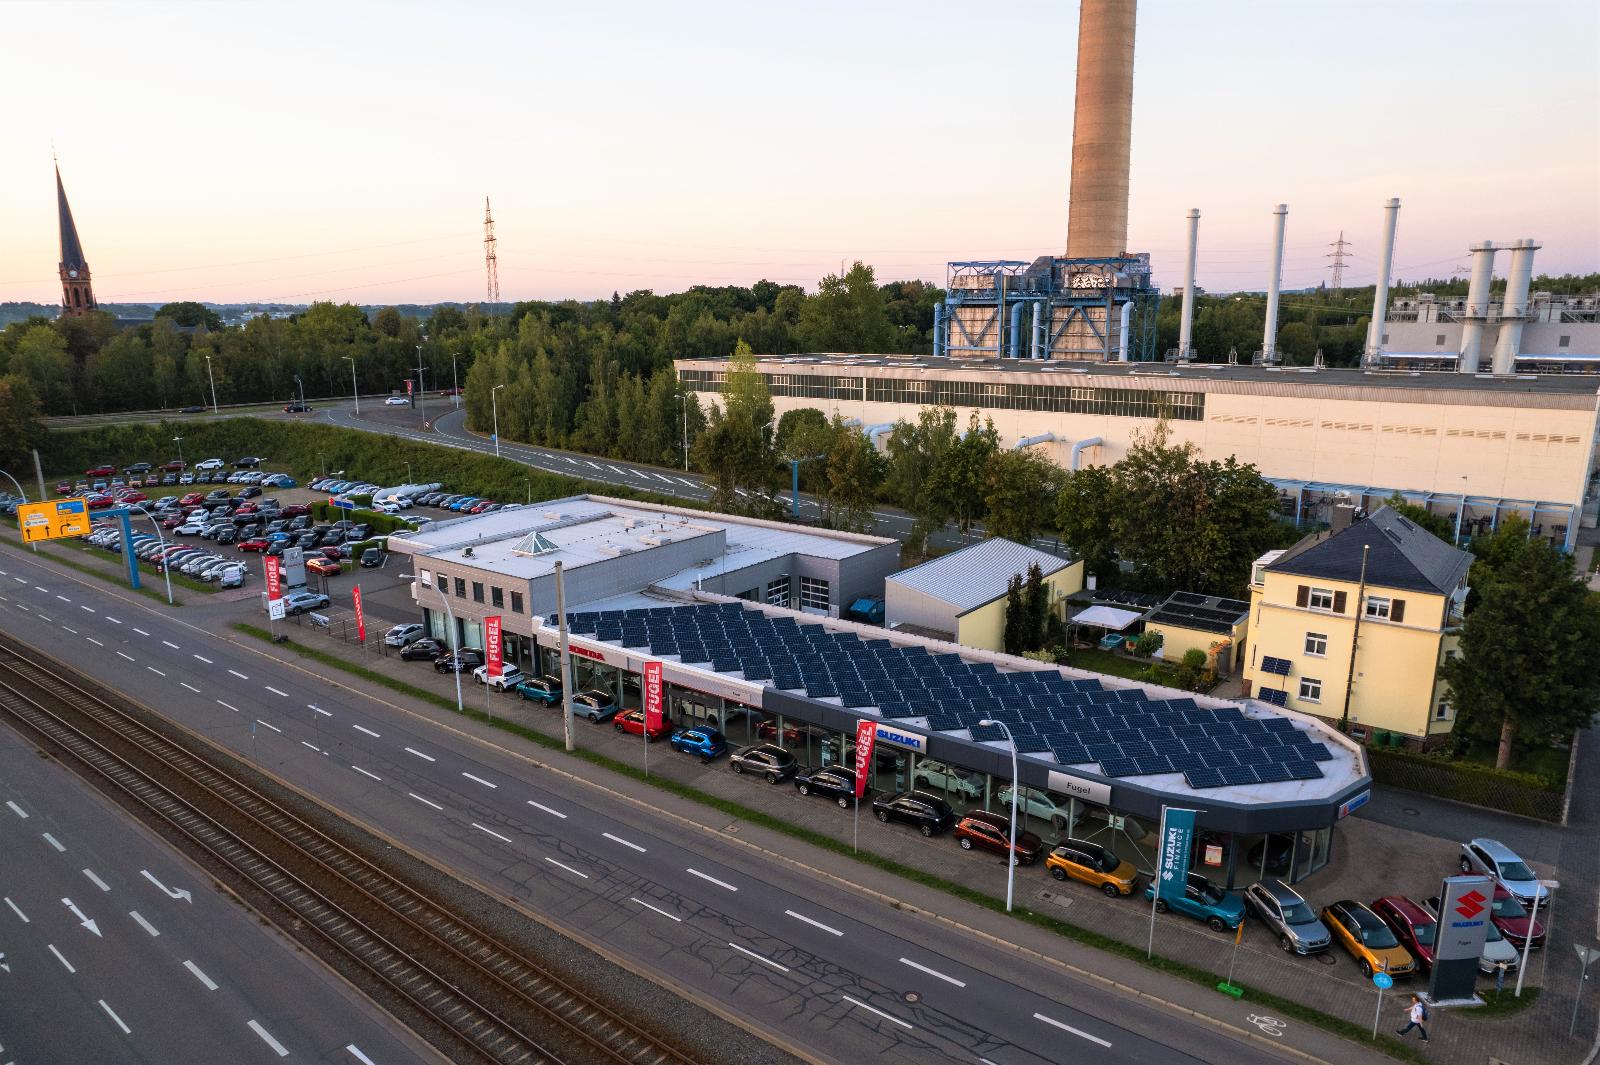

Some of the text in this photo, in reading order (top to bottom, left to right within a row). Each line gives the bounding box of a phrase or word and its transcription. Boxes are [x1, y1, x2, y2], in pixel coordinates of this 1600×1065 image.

[267, 559, 278, 592] FUGEL
[489, 619, 499, 661] FUGEL
[649, 666, 659, 713] FUGEL
[856, 726, 872, 779] FUGEL
[876, 729, 920, 748] SUZUKI
[1066, 781, 1091, 794] Fugel
[1165, 827, 1177, 870] SUZUKI
[1173, 828, 1184, 870] FINANCE
